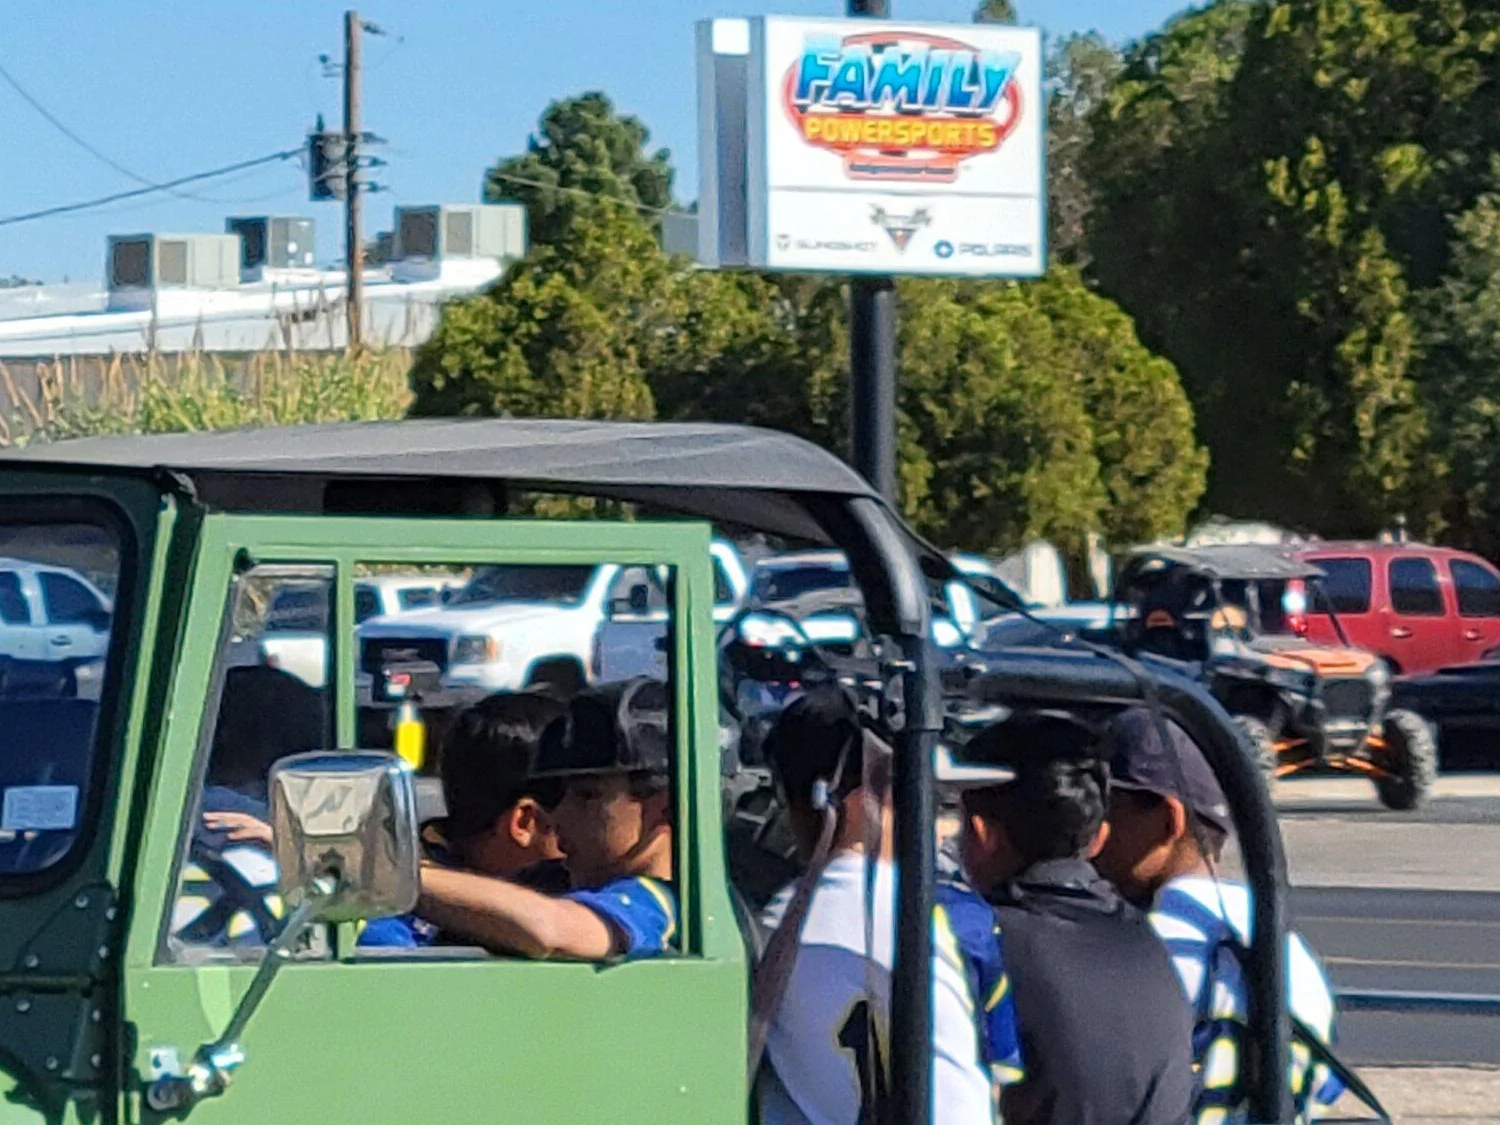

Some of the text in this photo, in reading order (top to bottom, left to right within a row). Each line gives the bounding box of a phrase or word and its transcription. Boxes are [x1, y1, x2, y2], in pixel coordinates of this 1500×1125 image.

[795, 37, 1021, 113] FAMILY
[804, 117, 996, 147] POWERSPORTS
[959, 242, 1033, 258] POLARIS
